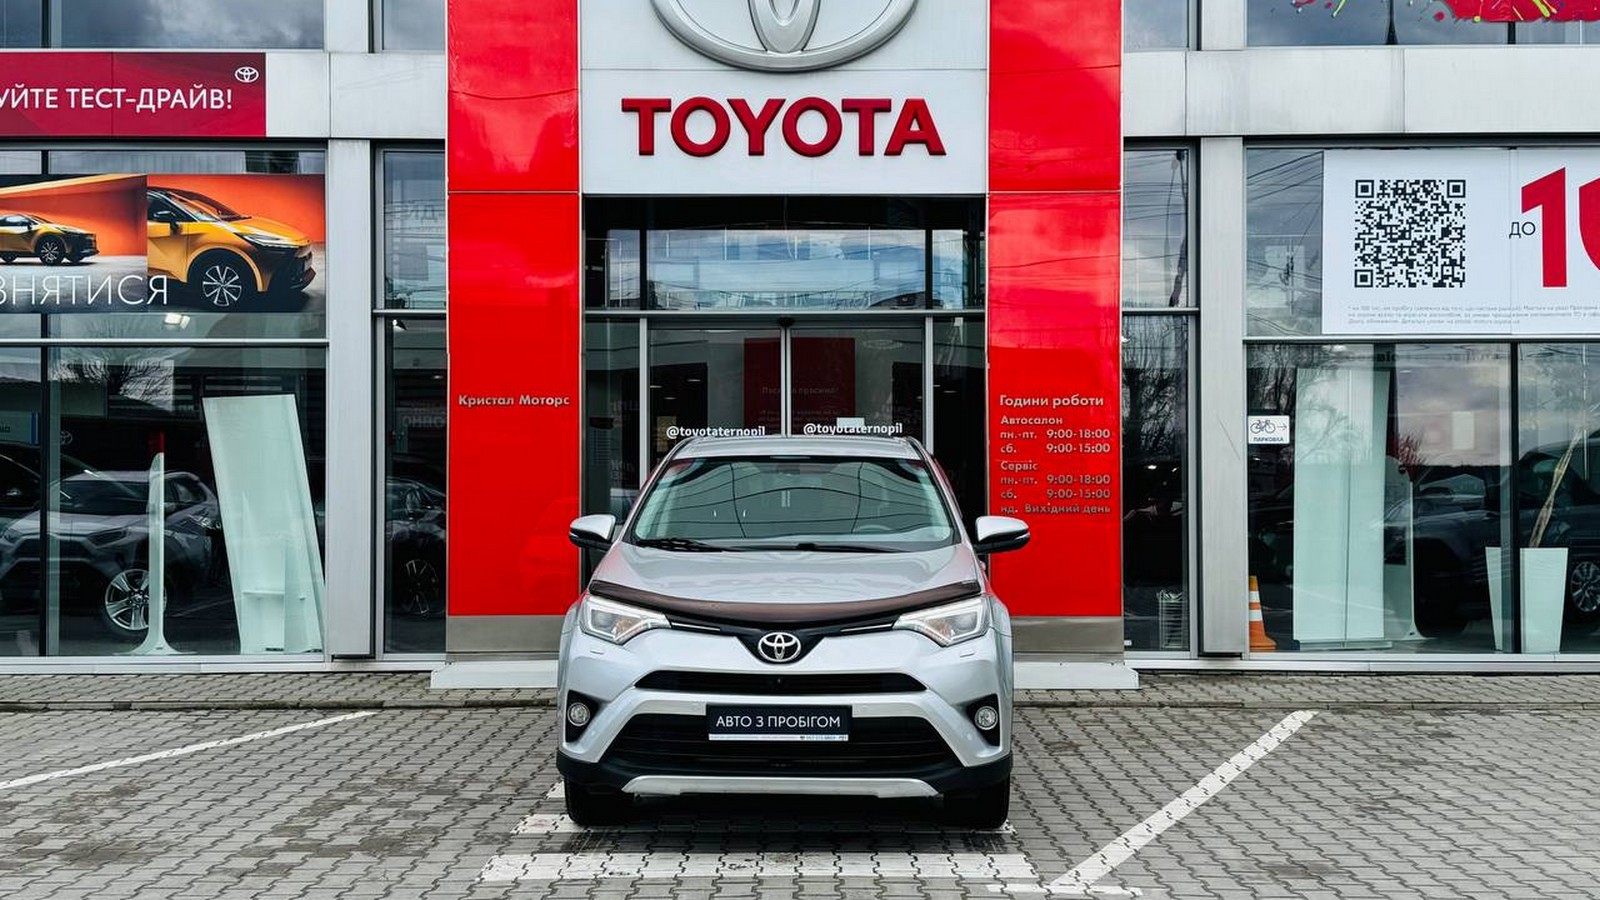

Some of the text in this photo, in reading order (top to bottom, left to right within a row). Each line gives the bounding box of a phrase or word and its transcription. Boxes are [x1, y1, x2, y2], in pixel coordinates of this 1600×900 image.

[66, 83, 232, 113] ТЕСТ-ДРАЙВ!
[621, 97, 946, 156] TOYOTA
[1509, 221, 1536, 239] до
[458, 395, 570, 408] Кристал Моторс
[1000, 394, 1104, 409] Години роботи
[1000, 415, 1063, 425] Автосалон
[803, 422, 903, 436] @toyotaternopil
[1046, 429, 1111, 439] 9:00-18:00
[1000, 443, 1111, 453] сб. 9:00-15:00
[1000, 460, 1038, 472] Сервіс
[1046, 474, 1111, 485] 9:00-18:00
[1000, 488, 1111, 499] сб. 9:00-15:00
[1024, 502, 1080, 515] Вихідний
[1083, 504, 1111, 515] день
[715, 715, 752, 728] АВТО
[767, 715, 841, 728] ПРОБІГОМ
